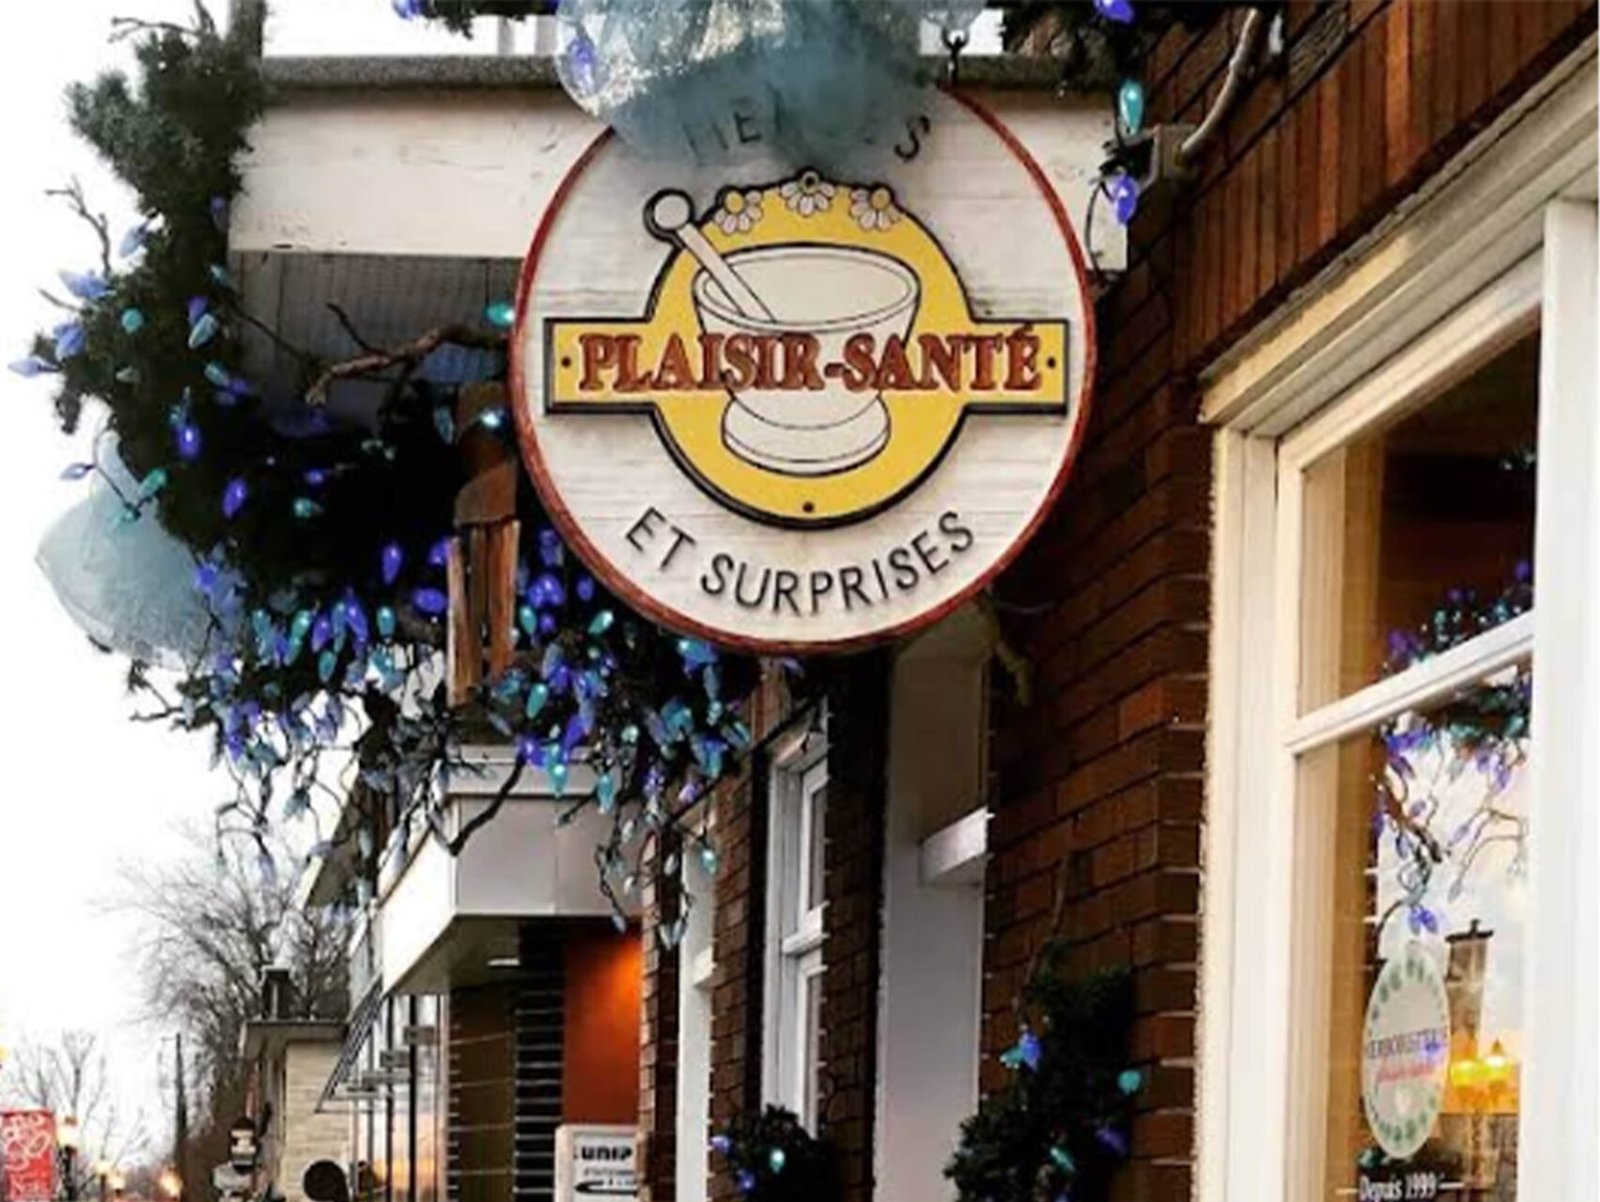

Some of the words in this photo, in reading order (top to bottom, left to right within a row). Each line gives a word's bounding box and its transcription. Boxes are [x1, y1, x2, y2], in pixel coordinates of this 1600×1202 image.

[577, 324, 1043, 393] PLAISIR-SANTÉ
[624, 506, 696, 571] ET
[699, 510, 976, 616] SURPRISES
[1405, 1172, 1437, 1199] 1999
